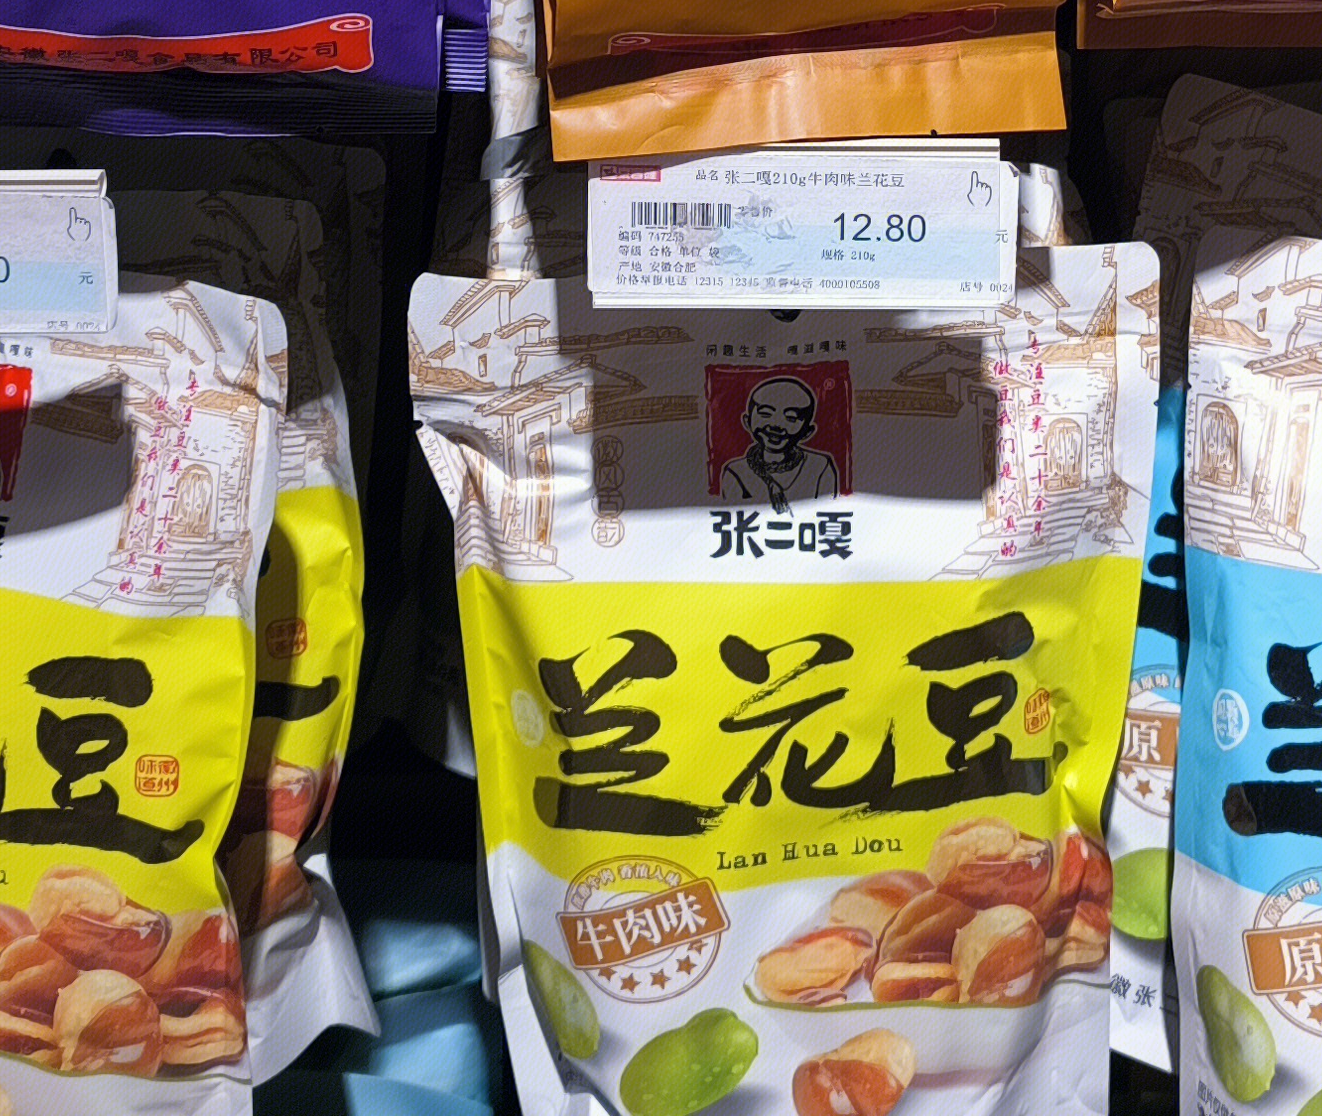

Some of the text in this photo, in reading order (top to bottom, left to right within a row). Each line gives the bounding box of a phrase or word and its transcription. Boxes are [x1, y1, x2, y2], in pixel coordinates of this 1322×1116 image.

[696, 170, 905, 190] 品名 张二嘎210g牛肉味兰花豆
[833, 212, 927, 242] 12.80
[995, 230, 1009, 243] 元
[649, 246, 701, 257] 合格 单位
[851, 251, 876, 262] 210g
[79, 272, 93, 284] 元
[649, 262, 696, 273] 安徽合肥
[989, 283, 1014, 292] 0024
[1028, 338, 1052, 536] 专注豆类二十余年
[994, 362, 1017, 557] 做豆我们是认真的
[709, 510, 854, 562] 张二嘎
[532, 611, 1068, 838] 兰花豆
[716, 834, 903, 872] Lan Hua Dou
[577, 892, 707, 962] 牛肉味
